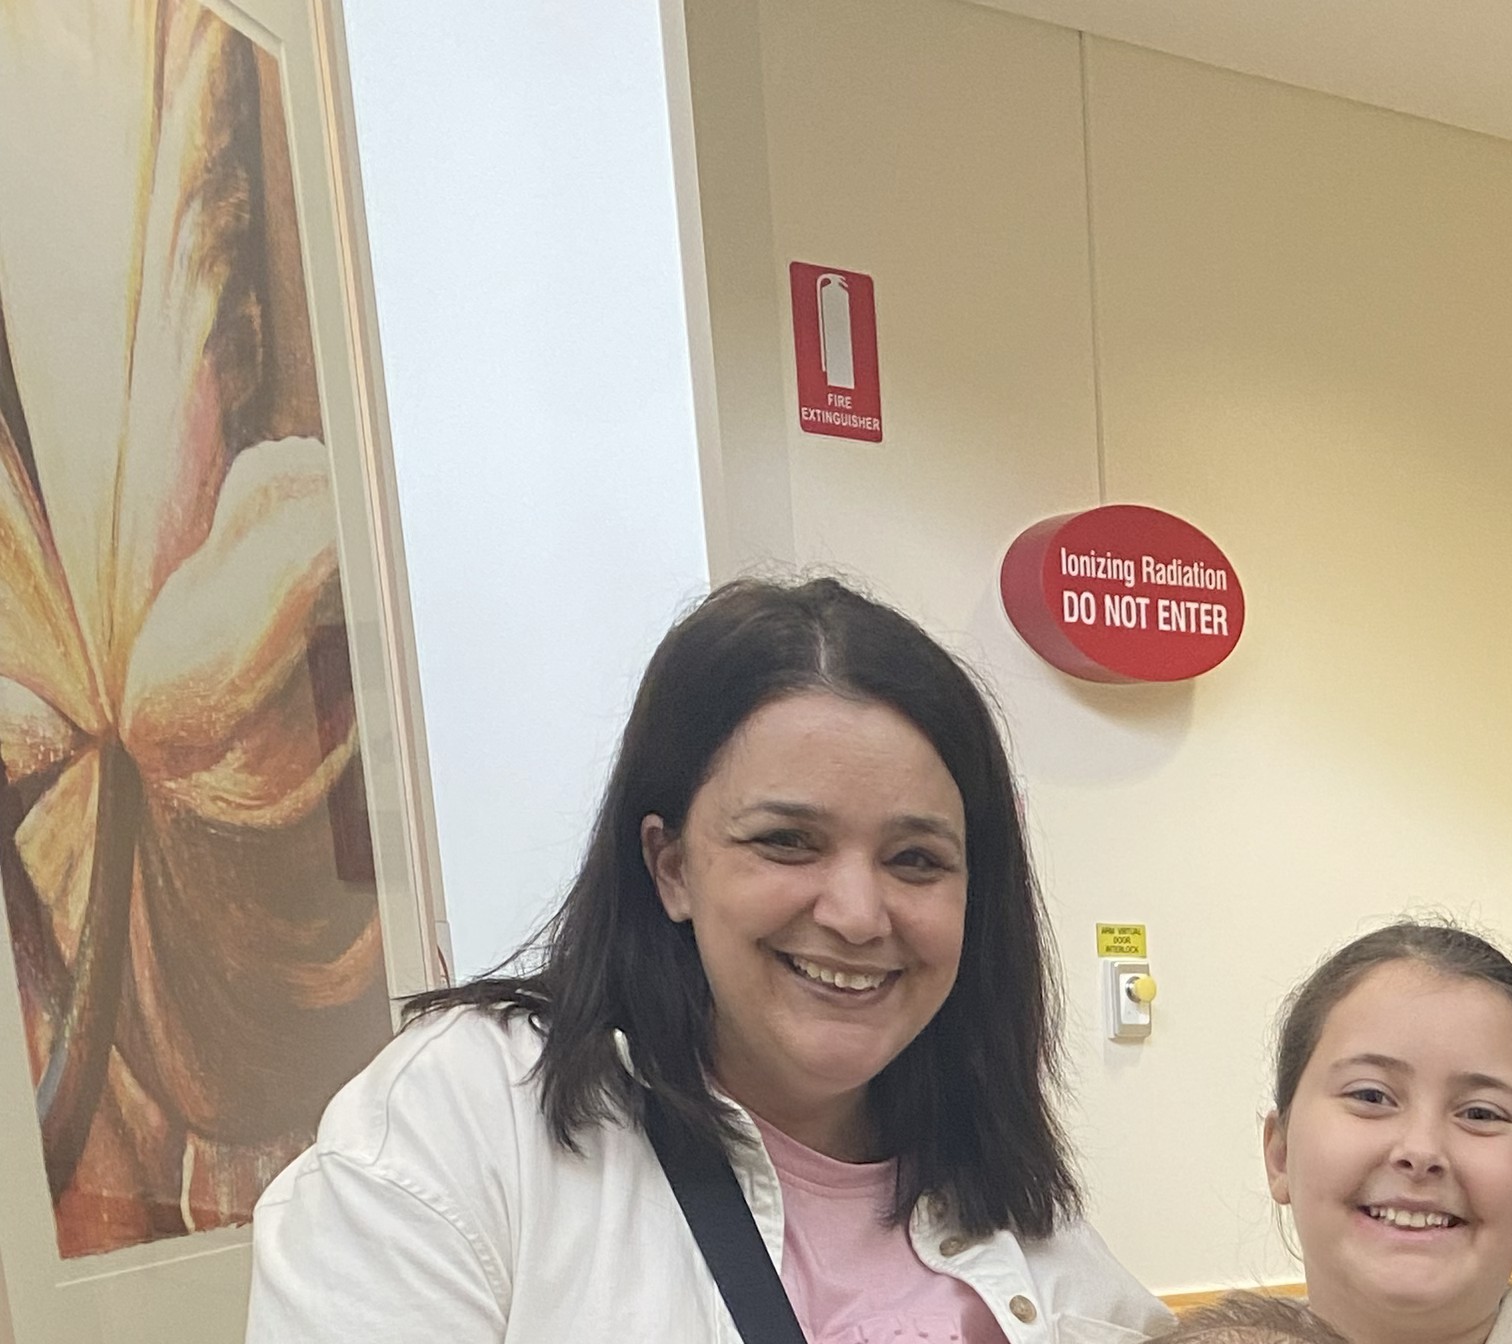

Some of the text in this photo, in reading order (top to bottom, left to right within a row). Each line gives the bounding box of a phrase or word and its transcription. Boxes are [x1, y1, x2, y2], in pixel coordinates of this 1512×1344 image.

[827, 393, 852, 409] FIRE
[801, 407, 880, 431] EXTINGUISHER
[1060, 547, 1227, 591] Ionizing Radiation
[1062, 590, 1229, 636] DO NOT ENTER
